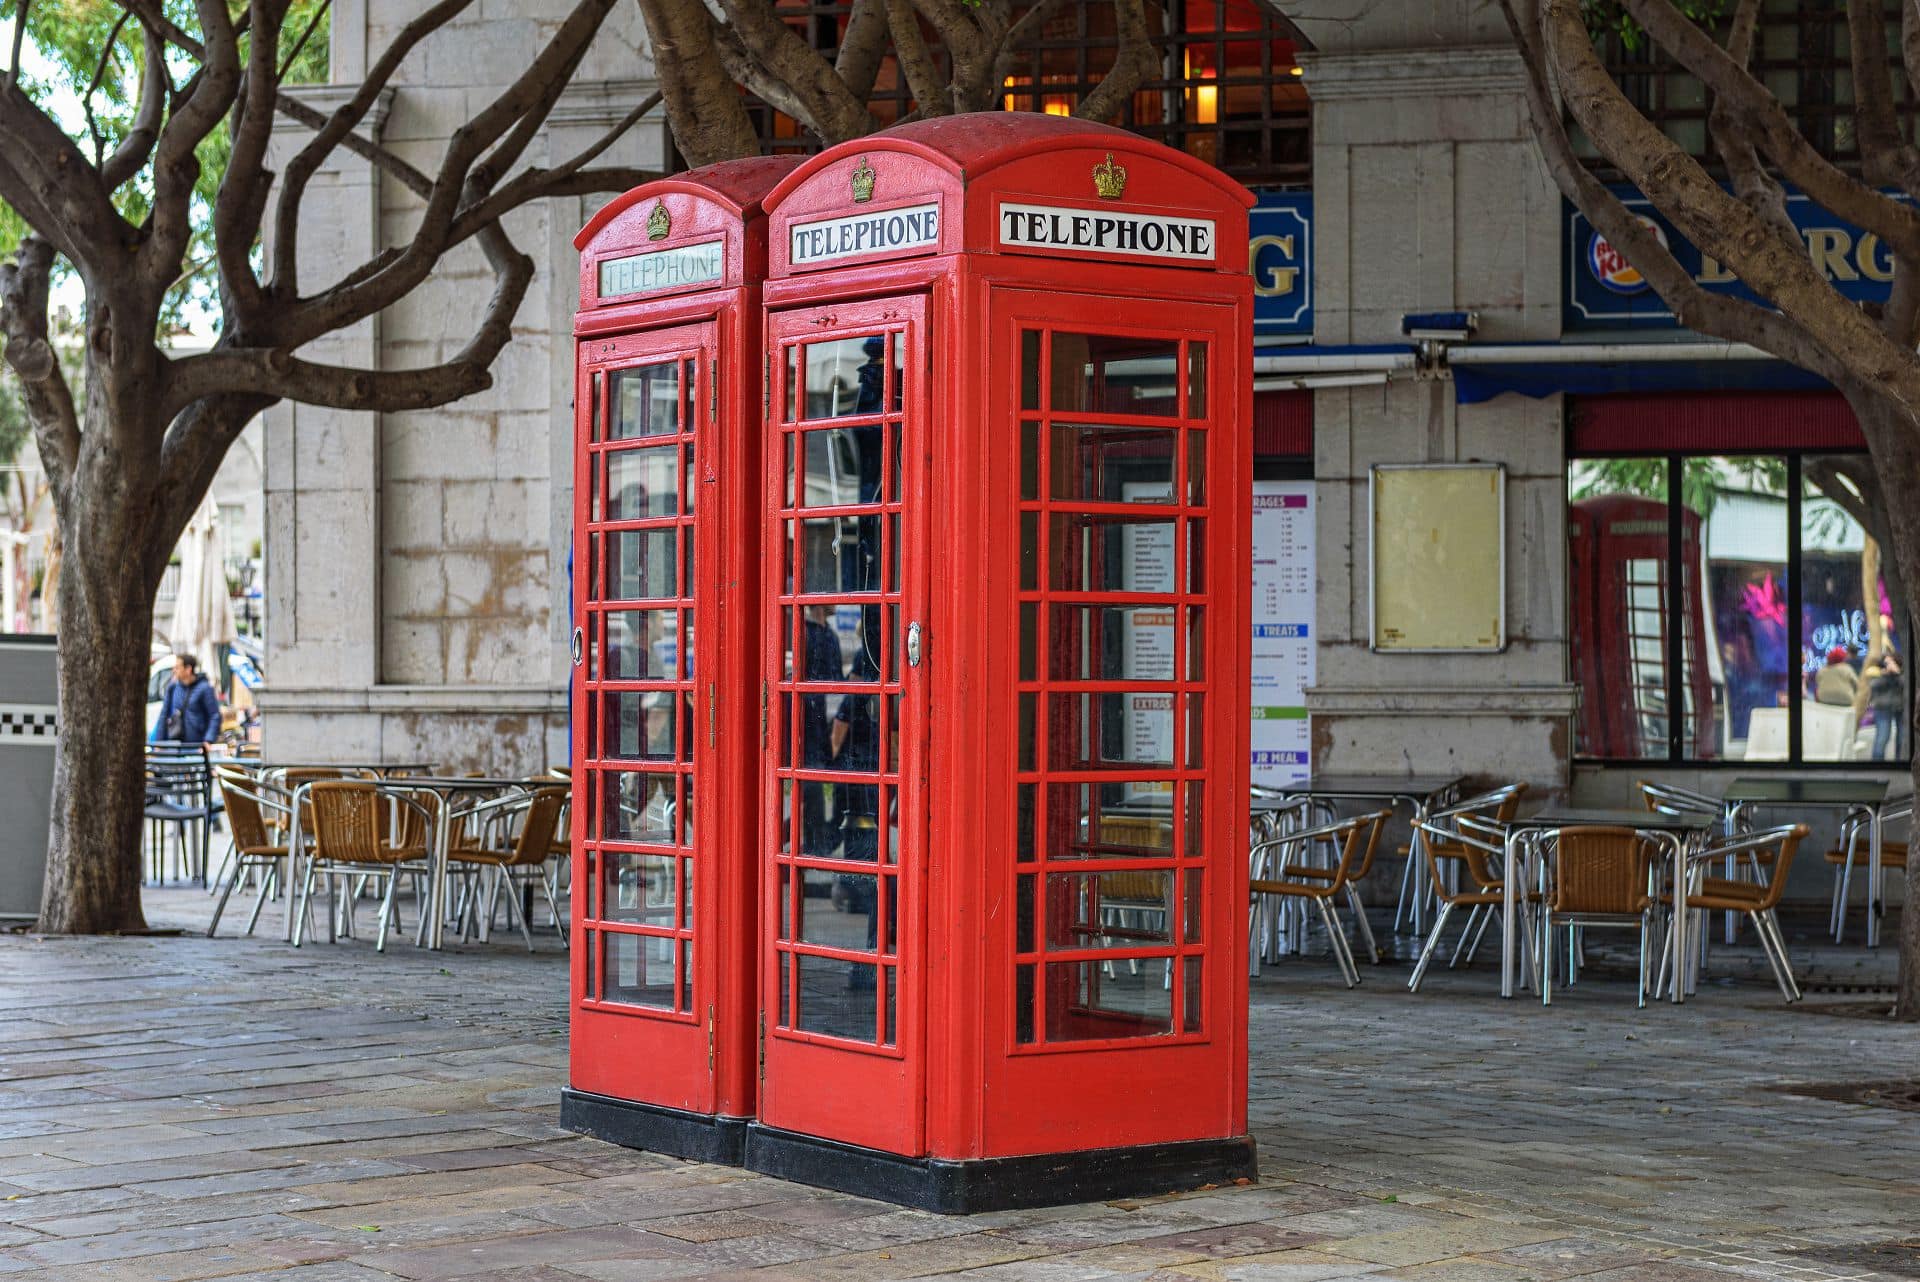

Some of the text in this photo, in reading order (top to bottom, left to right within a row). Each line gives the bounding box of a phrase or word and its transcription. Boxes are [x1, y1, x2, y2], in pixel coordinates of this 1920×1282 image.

[795, 210, 939, 259] TELEPHONE
[1003, 210, 1210, 255] TELEPHONE
[606, 248, 721, 292] TELEPHONE
[1263, 625, 1298, 637] TREATS
[1135, 698, 1171, 710] EXTRAS
[1271, 752, 1297, 764] MEAL
